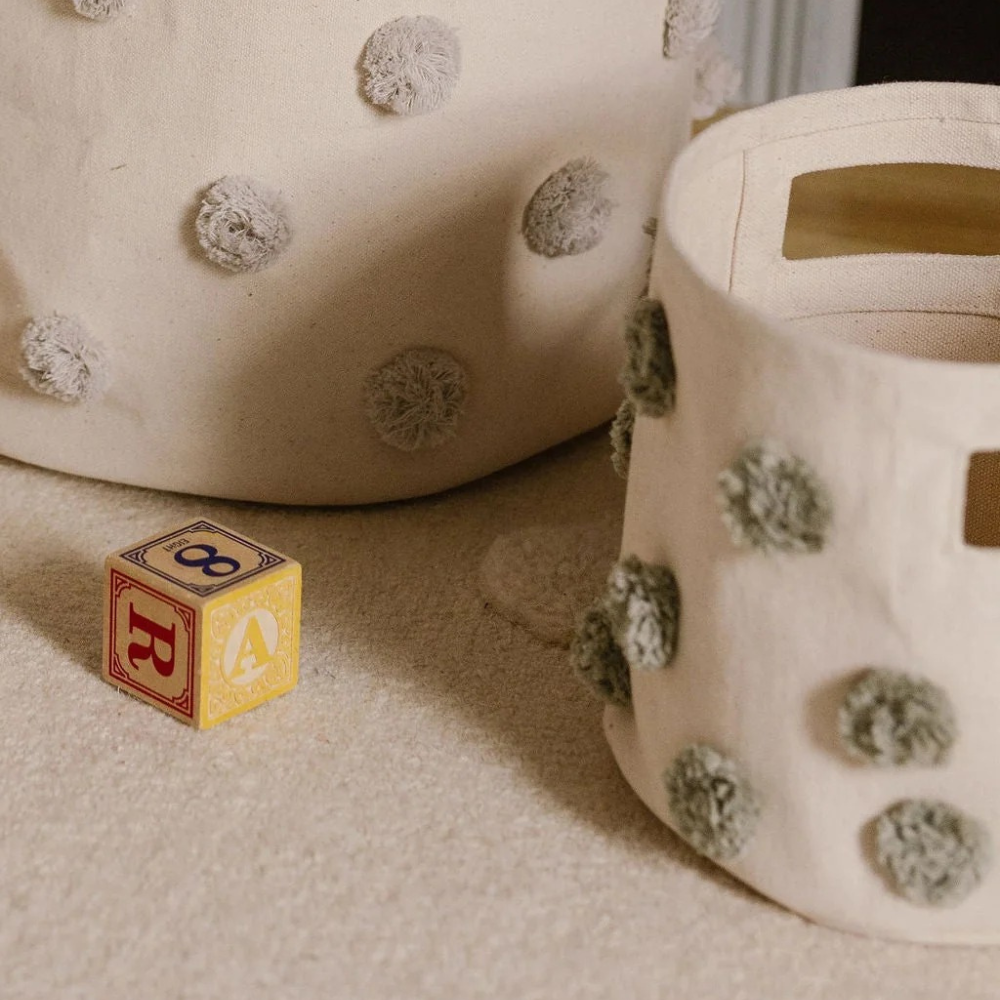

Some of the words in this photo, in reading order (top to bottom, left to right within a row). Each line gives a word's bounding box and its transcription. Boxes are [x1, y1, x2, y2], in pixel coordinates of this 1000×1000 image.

[174, 544, 240, 577] 8
[127, 602, 176, 677] R
[227, 616, 273, 679] A
